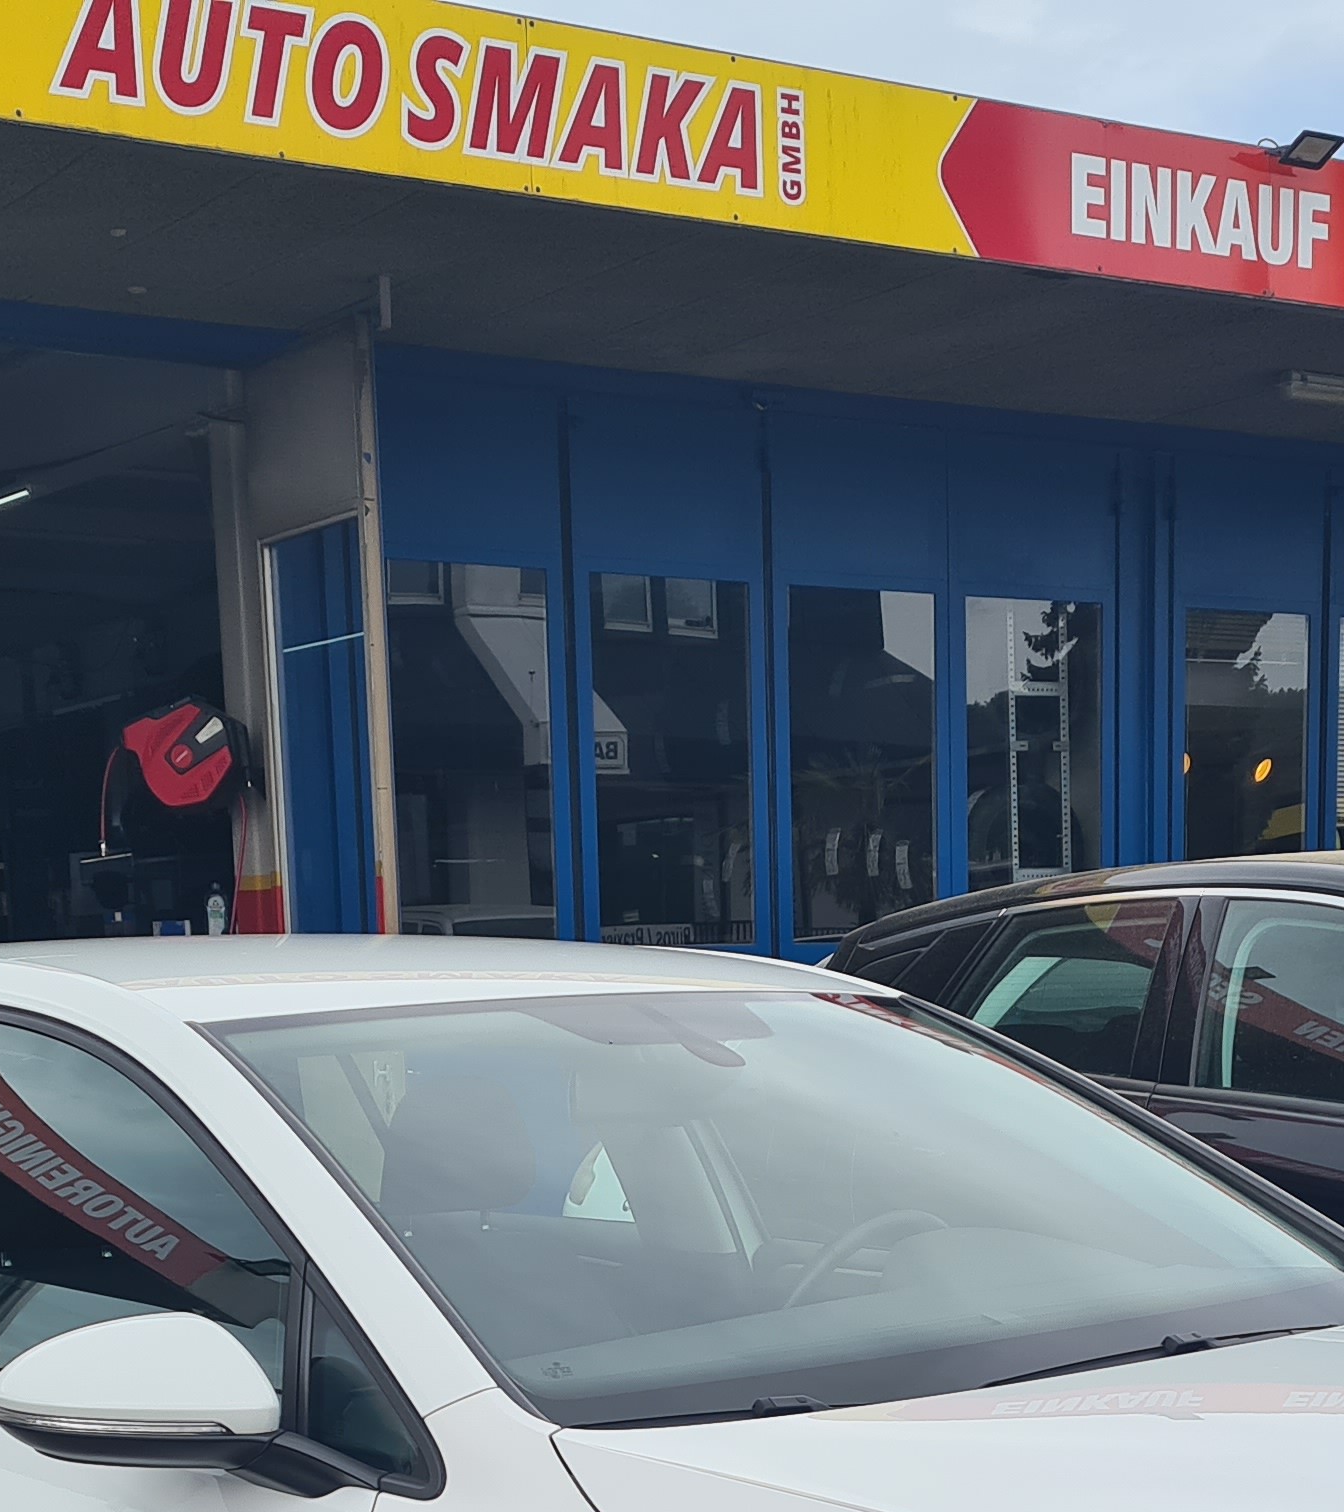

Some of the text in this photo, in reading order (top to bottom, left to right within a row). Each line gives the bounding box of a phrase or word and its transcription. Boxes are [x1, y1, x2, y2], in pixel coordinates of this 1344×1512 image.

[56, 0, 760, 194] AUTO SMAKA
[779, 91, 804, 203] GMBH
[1070, 153, 1331, 270] EINKAUF
